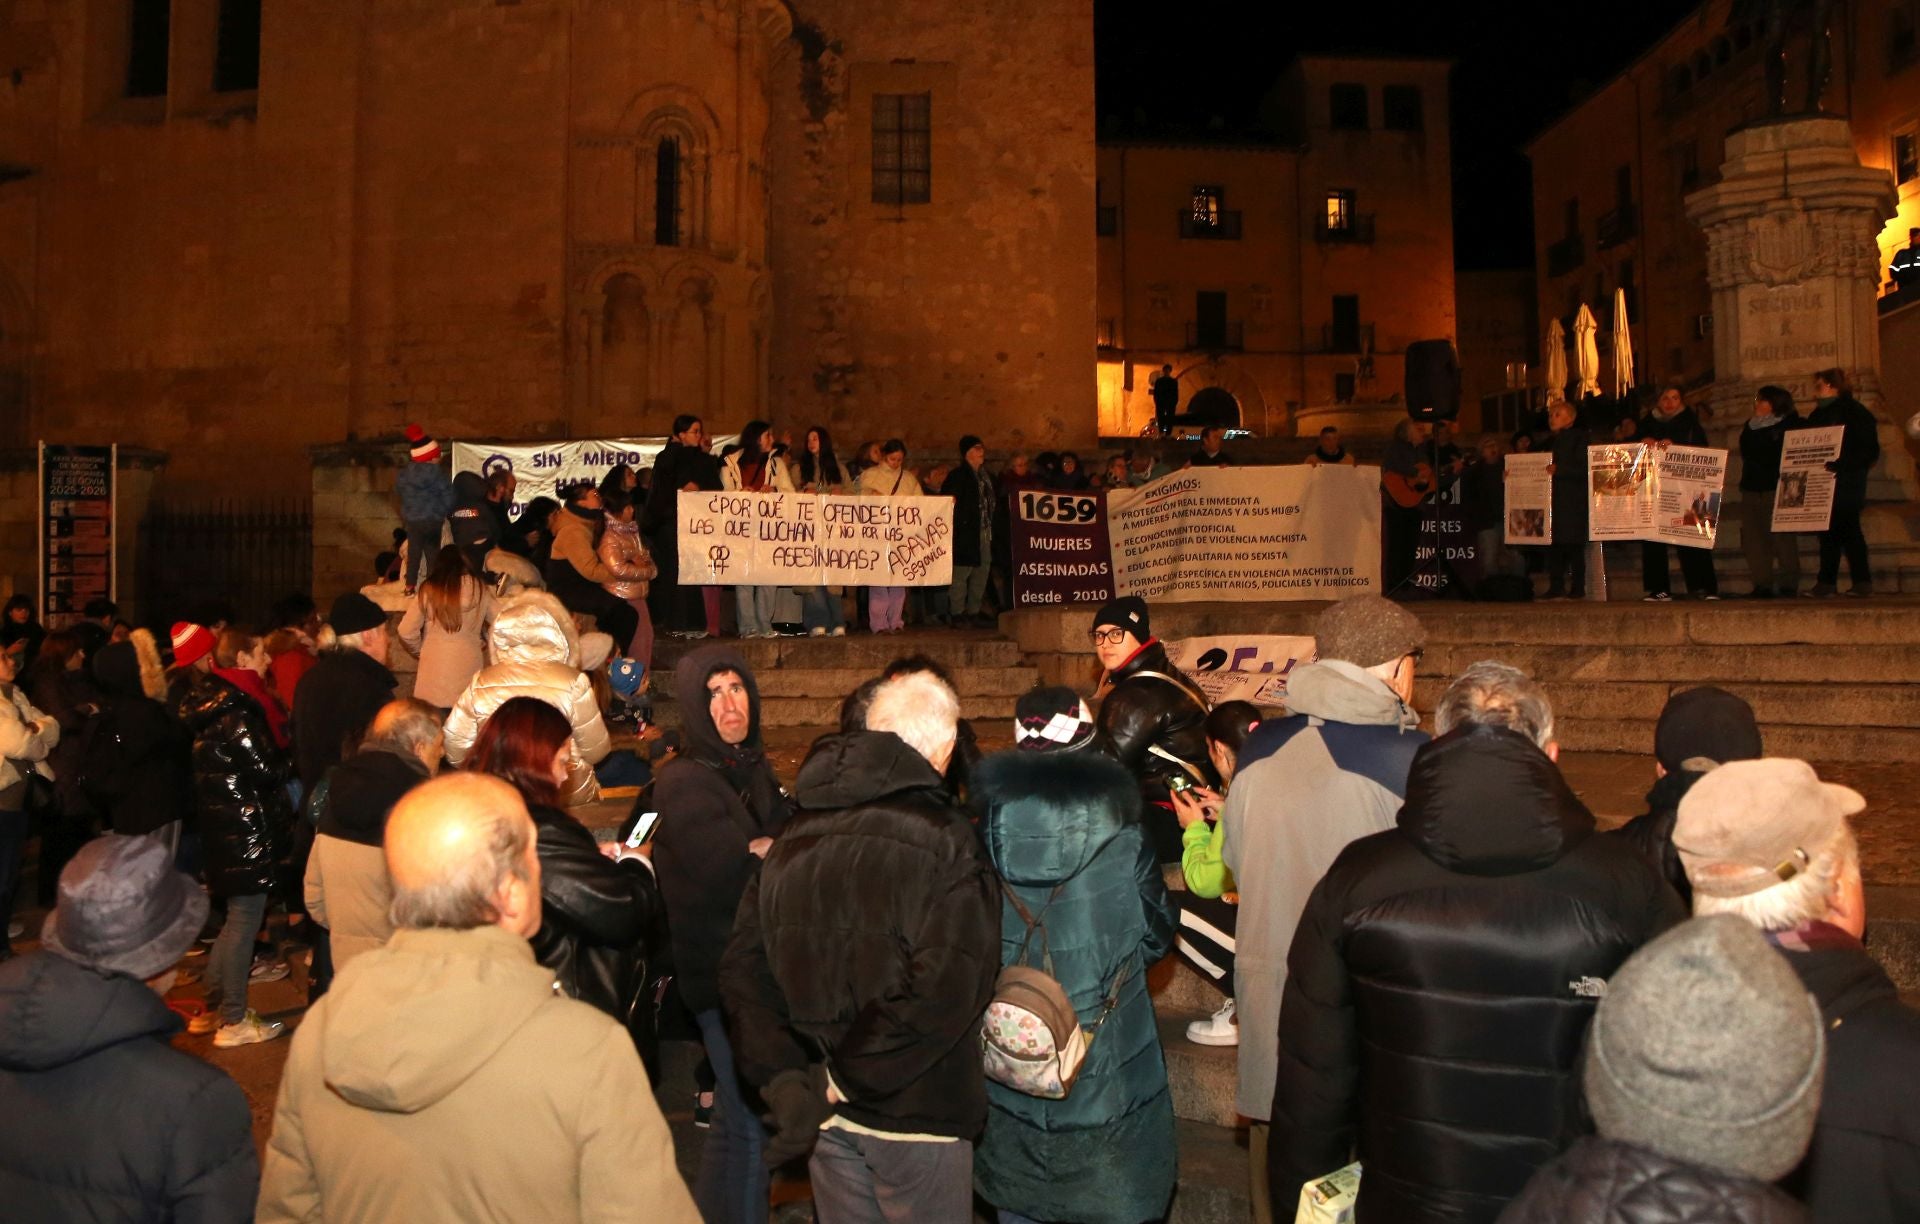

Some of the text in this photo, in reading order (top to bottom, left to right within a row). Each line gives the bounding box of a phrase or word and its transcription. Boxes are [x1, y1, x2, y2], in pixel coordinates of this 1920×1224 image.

[533, 449, 641, 468] SIN MIEDO
[1144, 479, 1201, 499] EXIGIMOS:
[708, 494, 922, 526] ¿POR QUÉ TE OFENDES POR
[1022, 493, 1097, 523] 1659
[1121, 501, 1177, 520] PROTECCIÓN
[1177, 498, 1198, 507] REAL
[1199, 498, 1205, 506] E
[1122, 505, 1300, 531] A MUJERES AMENAZADAS Y A SUS HIJ@S
[690, 517, 904, 542] LAS QUE LUCHAN Y NO POR LAS
[1200, 525, 1236, 534] OFICIAL
[887, 516, 949, 576] ADAVAS
[1030, 536, 1093, 551] MUJERES
[1125, 548, 1137, 557] DE
[1138, 546, 1149, 555] LA
[1195, 536, 1206, 544] DE
[1208, 535, 1258, 544] VIOLENCIA
[1259, 534, 1307, 543] MACHISTA
[1019, 562, 1109, 577] ASESINADAS
[1127, 554, 1178, 573] EDUCACIÓN
[1235, 552, 1249, 561] NO
[1251, 551, 1288, 560] SEXISTA
[1178, 568, 1227, 579] ESPECÍFICA
[1228, 569, 1241, 578] EN
[1242, 568, 1290, 578] VIOLENCIA
[1292, 567, 1340, 577] MACHISTA
[1342, 567, 1354, 575] DE
[1262, 577, 1312, 588] POLICIALES
[1314, 578, 1321, 587] Y
[1322, 576, 1369, 587] JURÍDICOS
[1021, 589, 1108, 604] desde 2010
